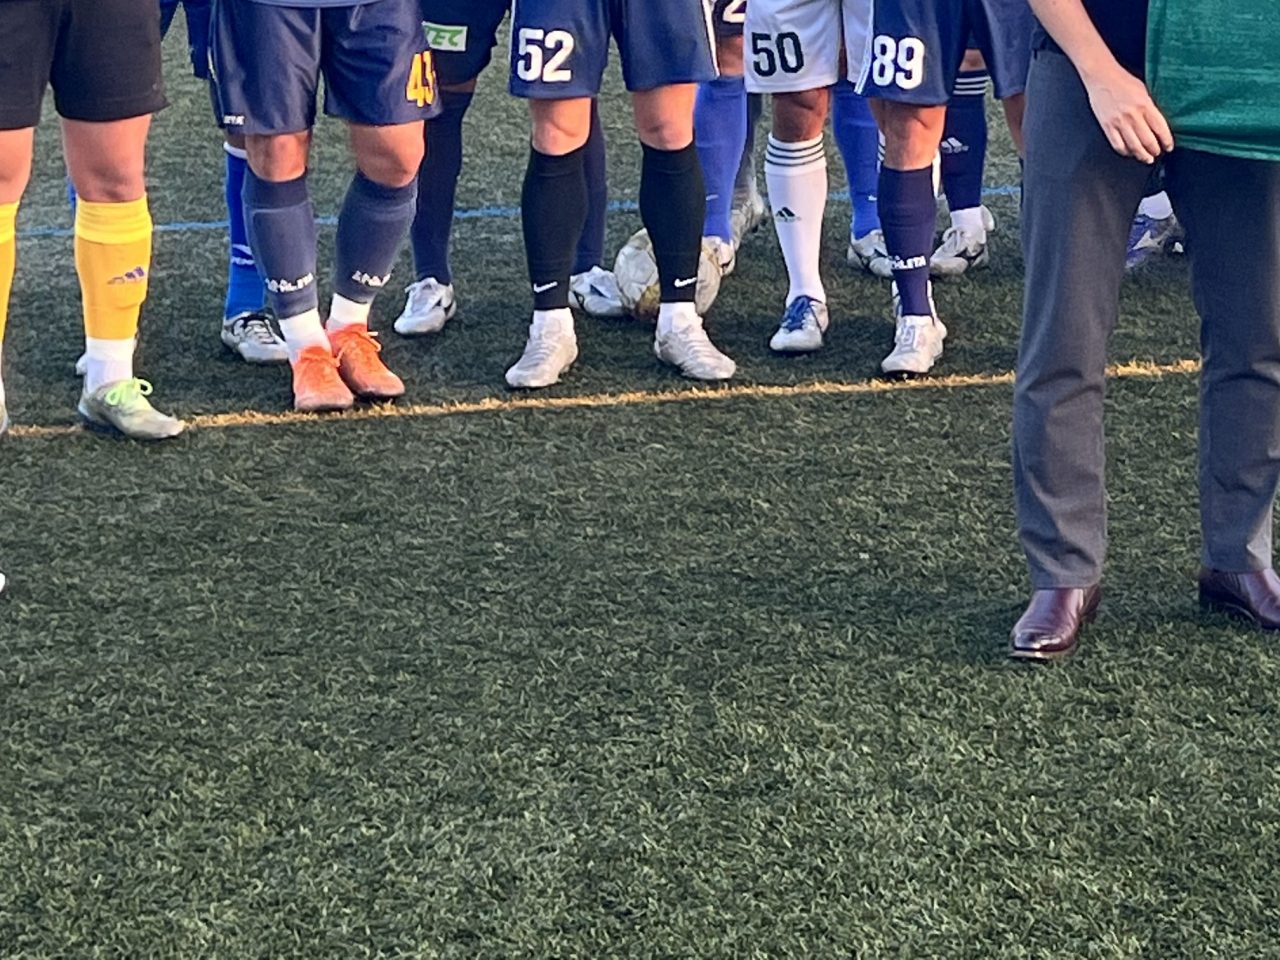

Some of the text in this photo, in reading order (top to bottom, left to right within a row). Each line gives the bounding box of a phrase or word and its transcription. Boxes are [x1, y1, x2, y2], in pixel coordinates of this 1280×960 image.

[517, 28, 574, 82] 52
[751, 31, 804, 77] 50
[872, 34, 925, 90] 89
